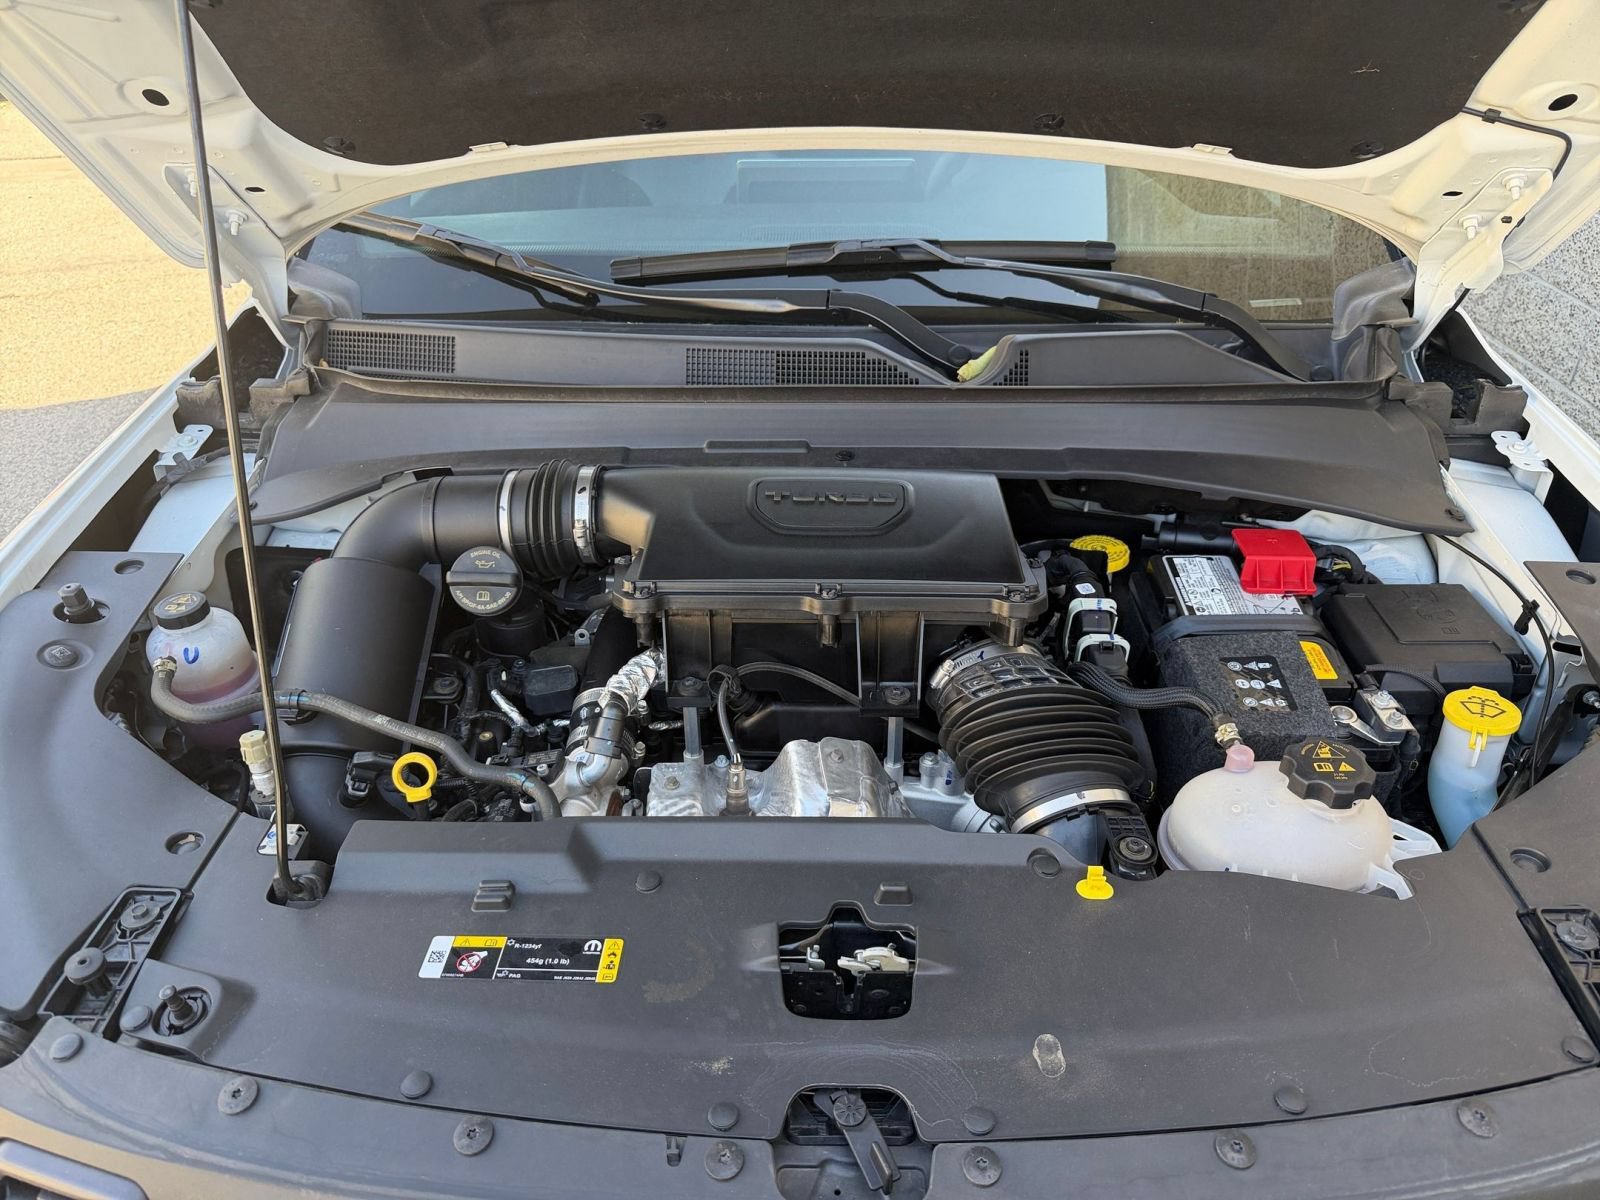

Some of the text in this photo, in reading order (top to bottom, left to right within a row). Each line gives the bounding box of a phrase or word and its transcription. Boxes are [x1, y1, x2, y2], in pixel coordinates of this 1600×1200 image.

[470, 549, 491, 558] ENGINE
[526, 957, 570, 966] 454g (1.0 lb)
